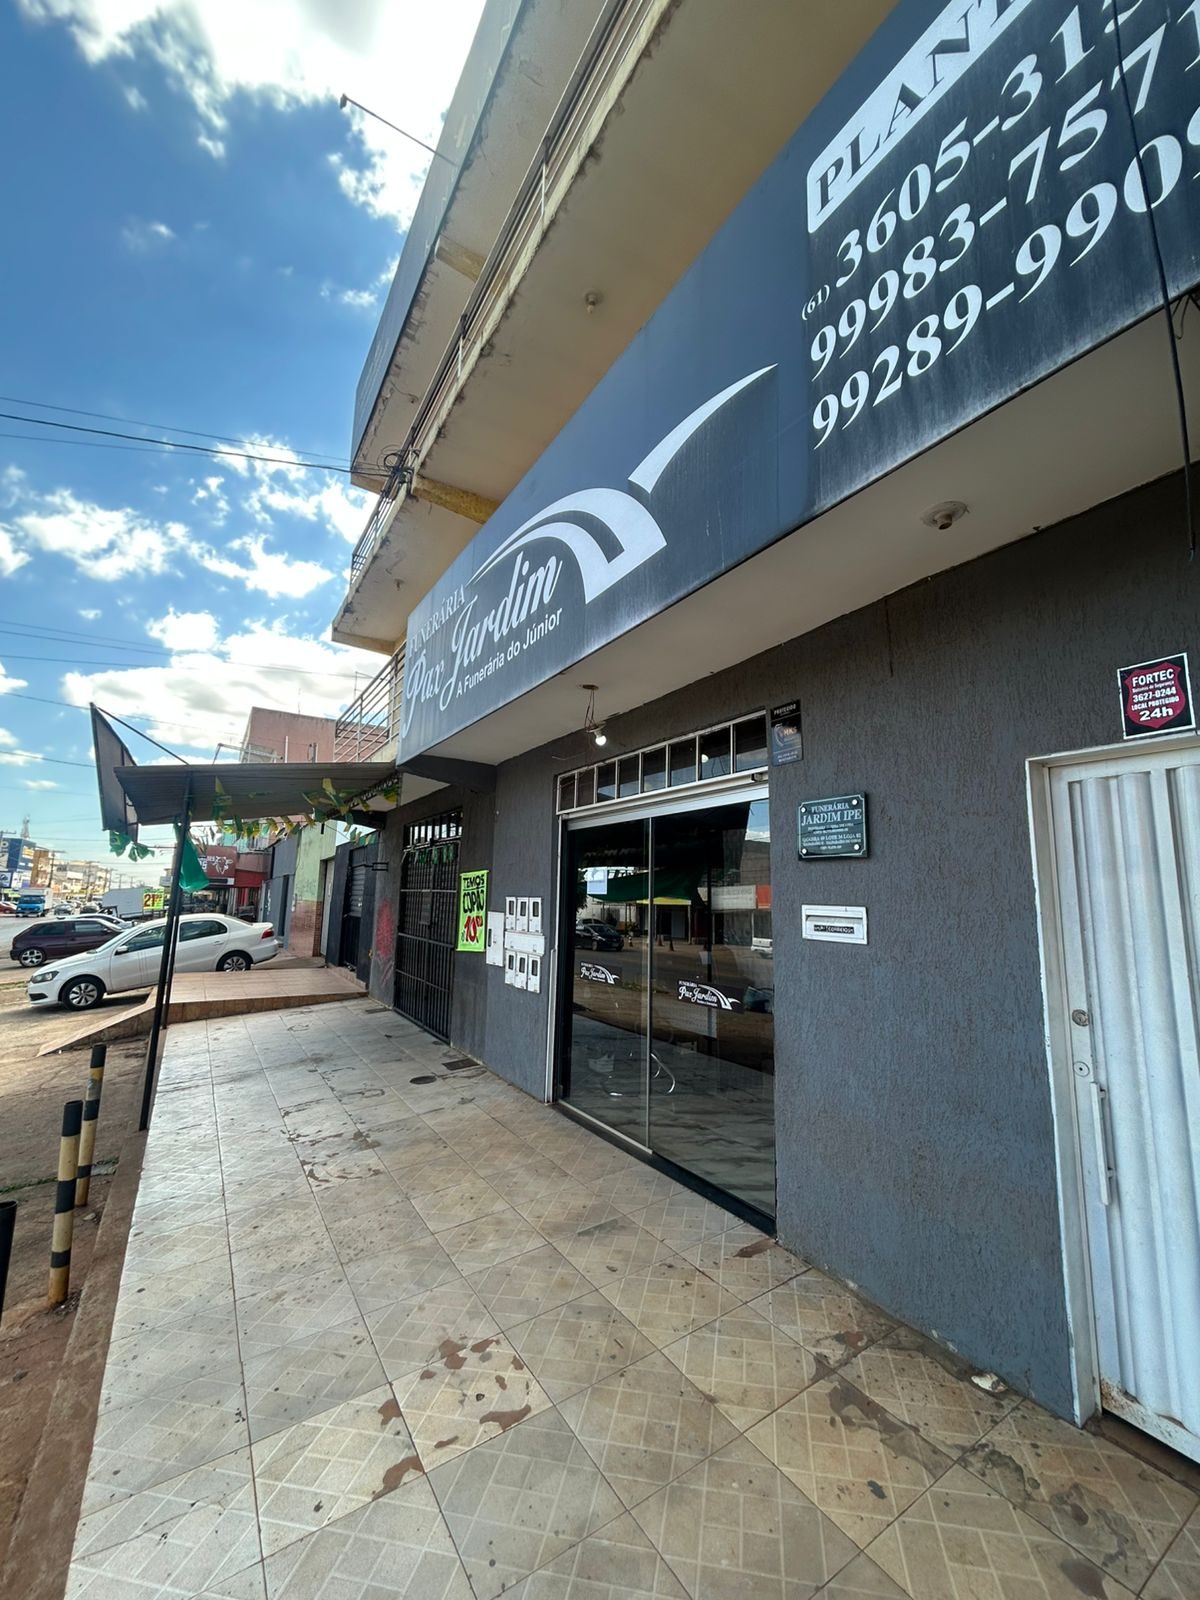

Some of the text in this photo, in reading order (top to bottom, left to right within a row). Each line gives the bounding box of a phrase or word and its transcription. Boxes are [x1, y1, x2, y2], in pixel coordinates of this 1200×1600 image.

[812, 106, 1200, 450] 99289-990
[802, 284, 830, 320] (61)
[408, 583, 465, 658] FUNERÁRIA
[402, 550, 563, 739] Pax Jardim
[456, 607, 563, 699] A Funerária do Júnior
[1131, 668, 1175, 688] FORTEC
[1131, 701, 1148, 711] LOCAL
[1139, 706, 1174, 722] 24h
[811, 801, 850, 813] FUNERÁRIA
[801, 811, 842, 826] JARDIM
[463, 874, 485, 889] TEMOS
